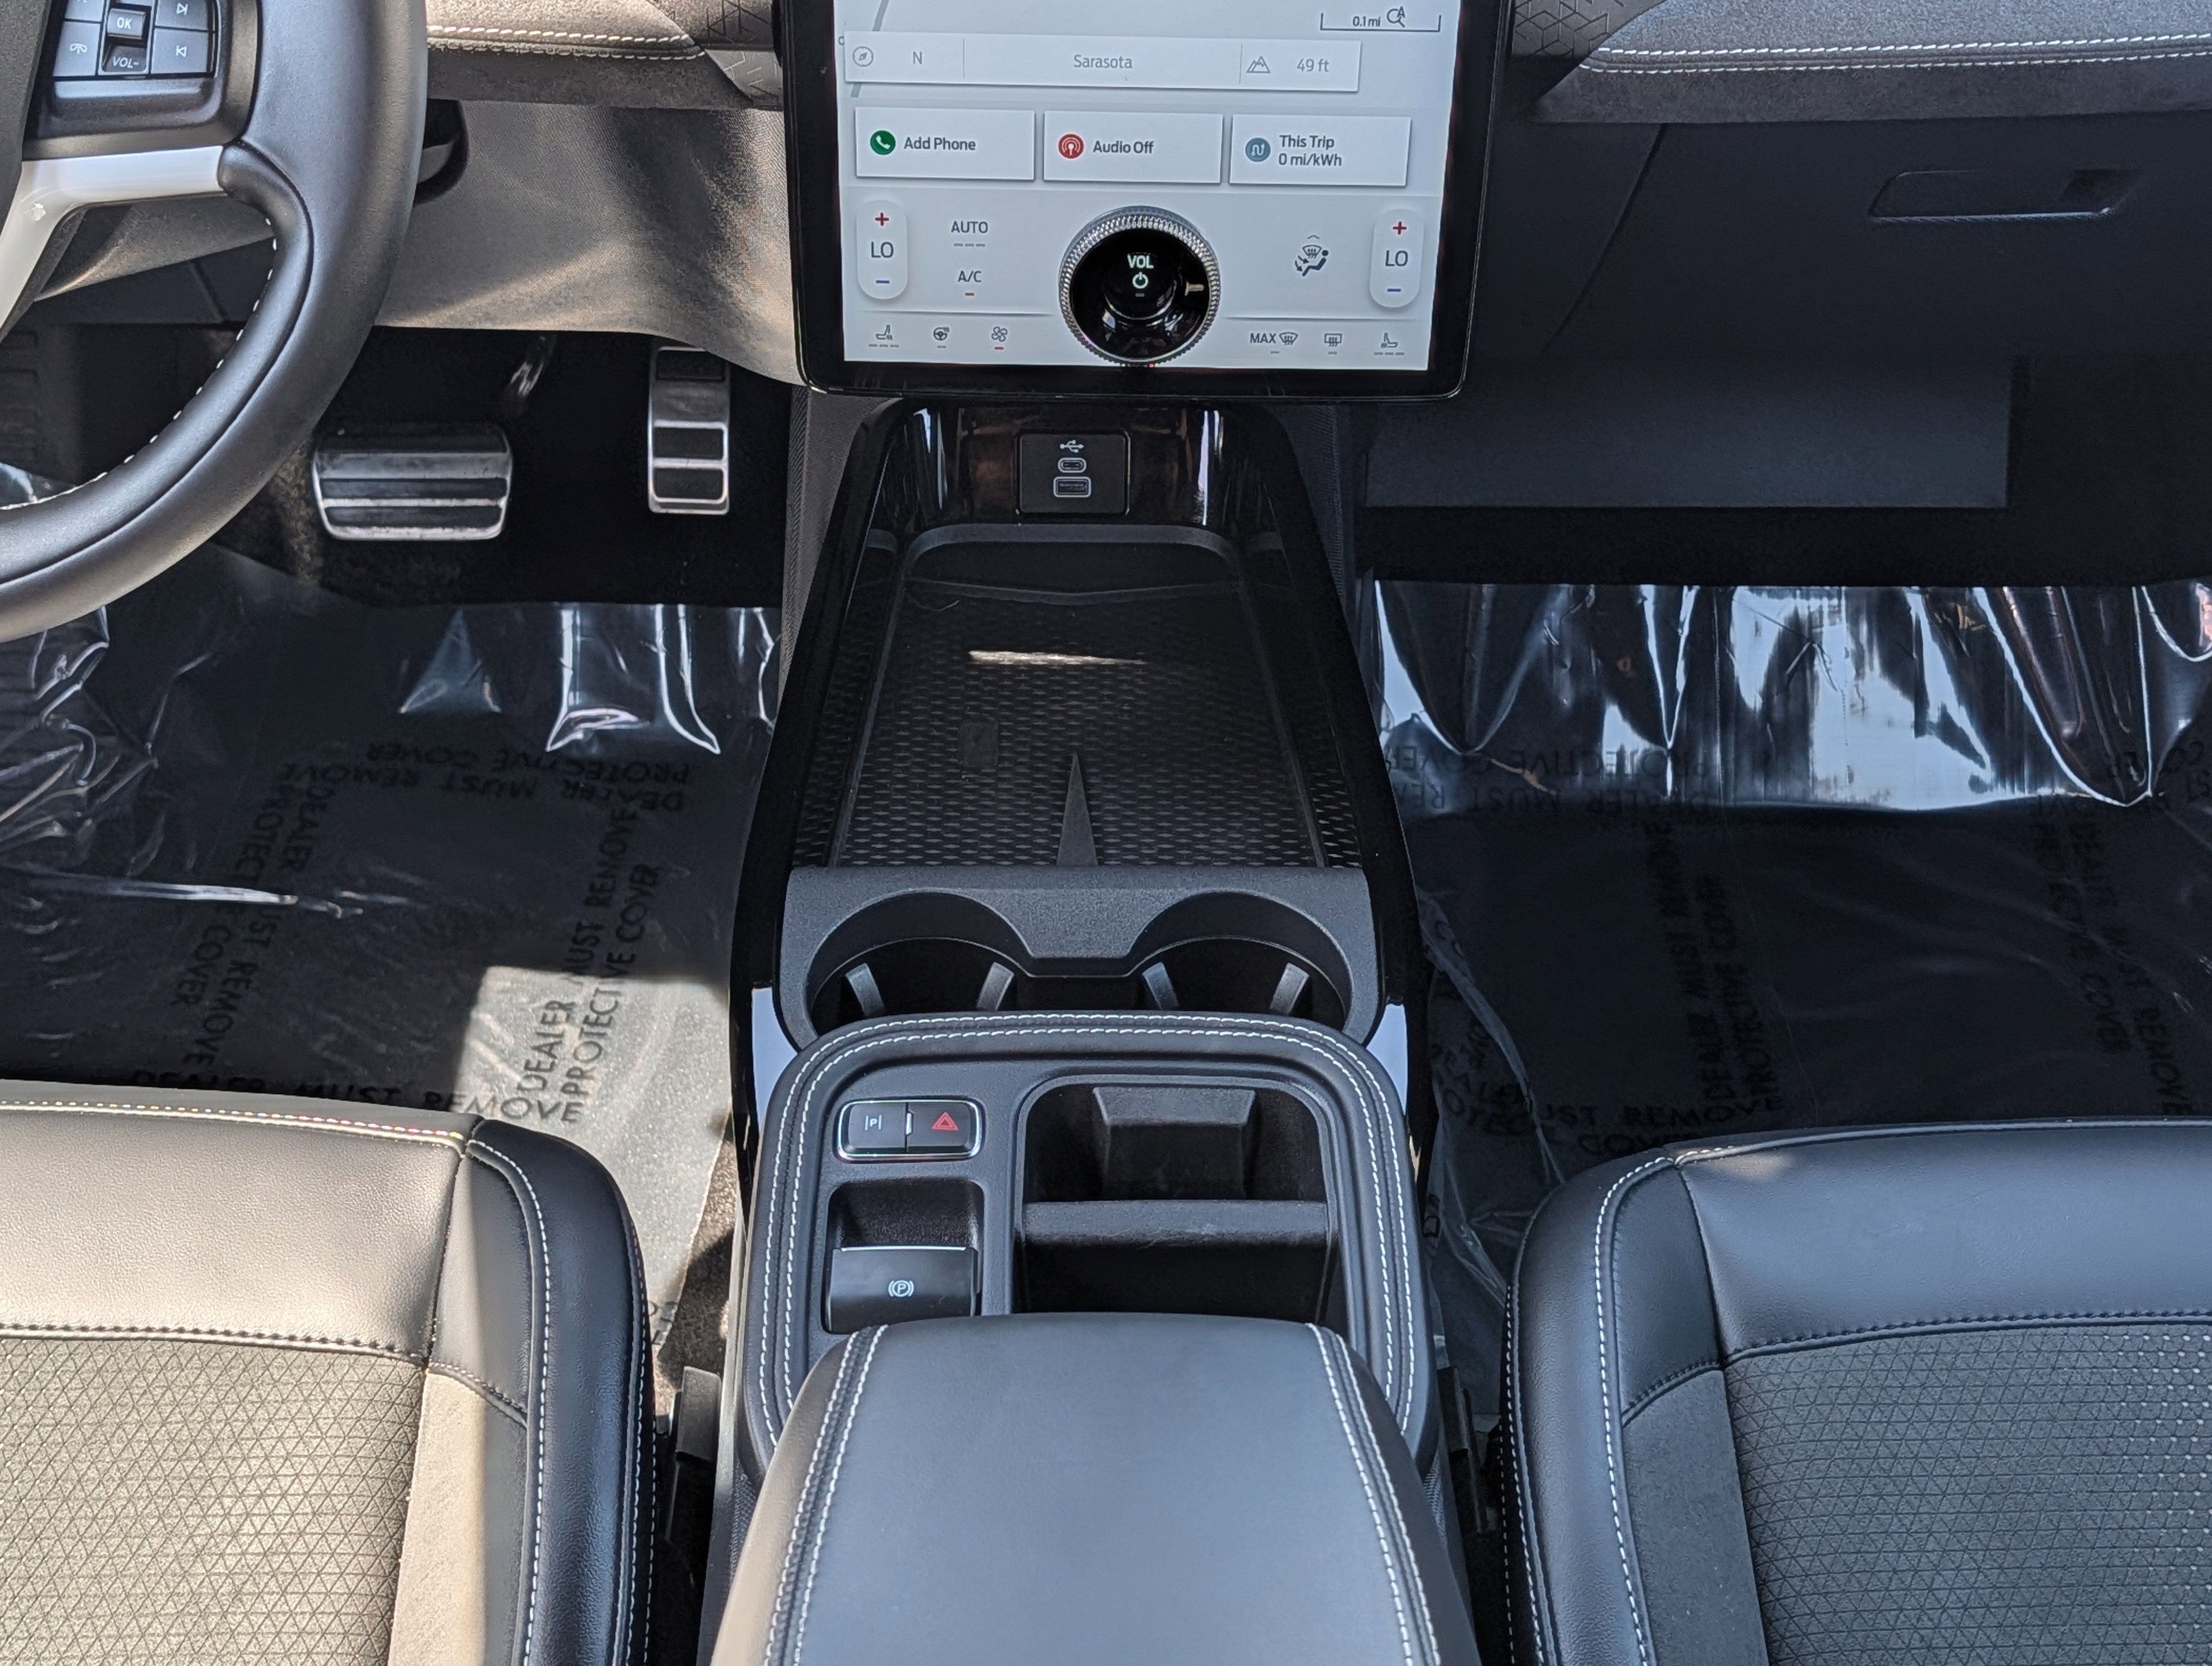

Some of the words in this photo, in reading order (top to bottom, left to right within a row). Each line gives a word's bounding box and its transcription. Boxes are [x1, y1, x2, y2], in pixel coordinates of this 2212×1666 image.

[117, 17, 132, 29] OK
[913, 51, 922, 65] N
[1073, 54, 1133, 69] Sarasota
[1296, 59, 1314, 72] 49
[1319, 59, 1329, 73] ft
[904, 136, 930, 150] Add
[934, 137, 976, 151] Phone
[1093, 140, 1131, 153] Audio
[1134, 140, 1154, 154] Off
[1279, 134, 1307, 148] This
[1309, 135, 1335, 151] Trip
[1278, 153, 1288, 165] 0
[1290, 153, 1342, 166] mi/kWh
[951, 221, 988, 234] AUTO
[871, 241, 894, 259] LO
[1127, 254, 1154, 269] VOL
[1385, 249, 1409, 267] LO
[957, 270, 982, 283] A/C
[1250, 333, 1277, 344] MAX
[440, 772, 538, 799] MUST
[170, 924, 232, 1007] COVER
[560, 951, 637, 1098] PROTECTIVE
[618, 864, 661, 943] COVER
[182, 960, 260, 1067] REMOVE
[517, 999, 576, 1092] DEALER
